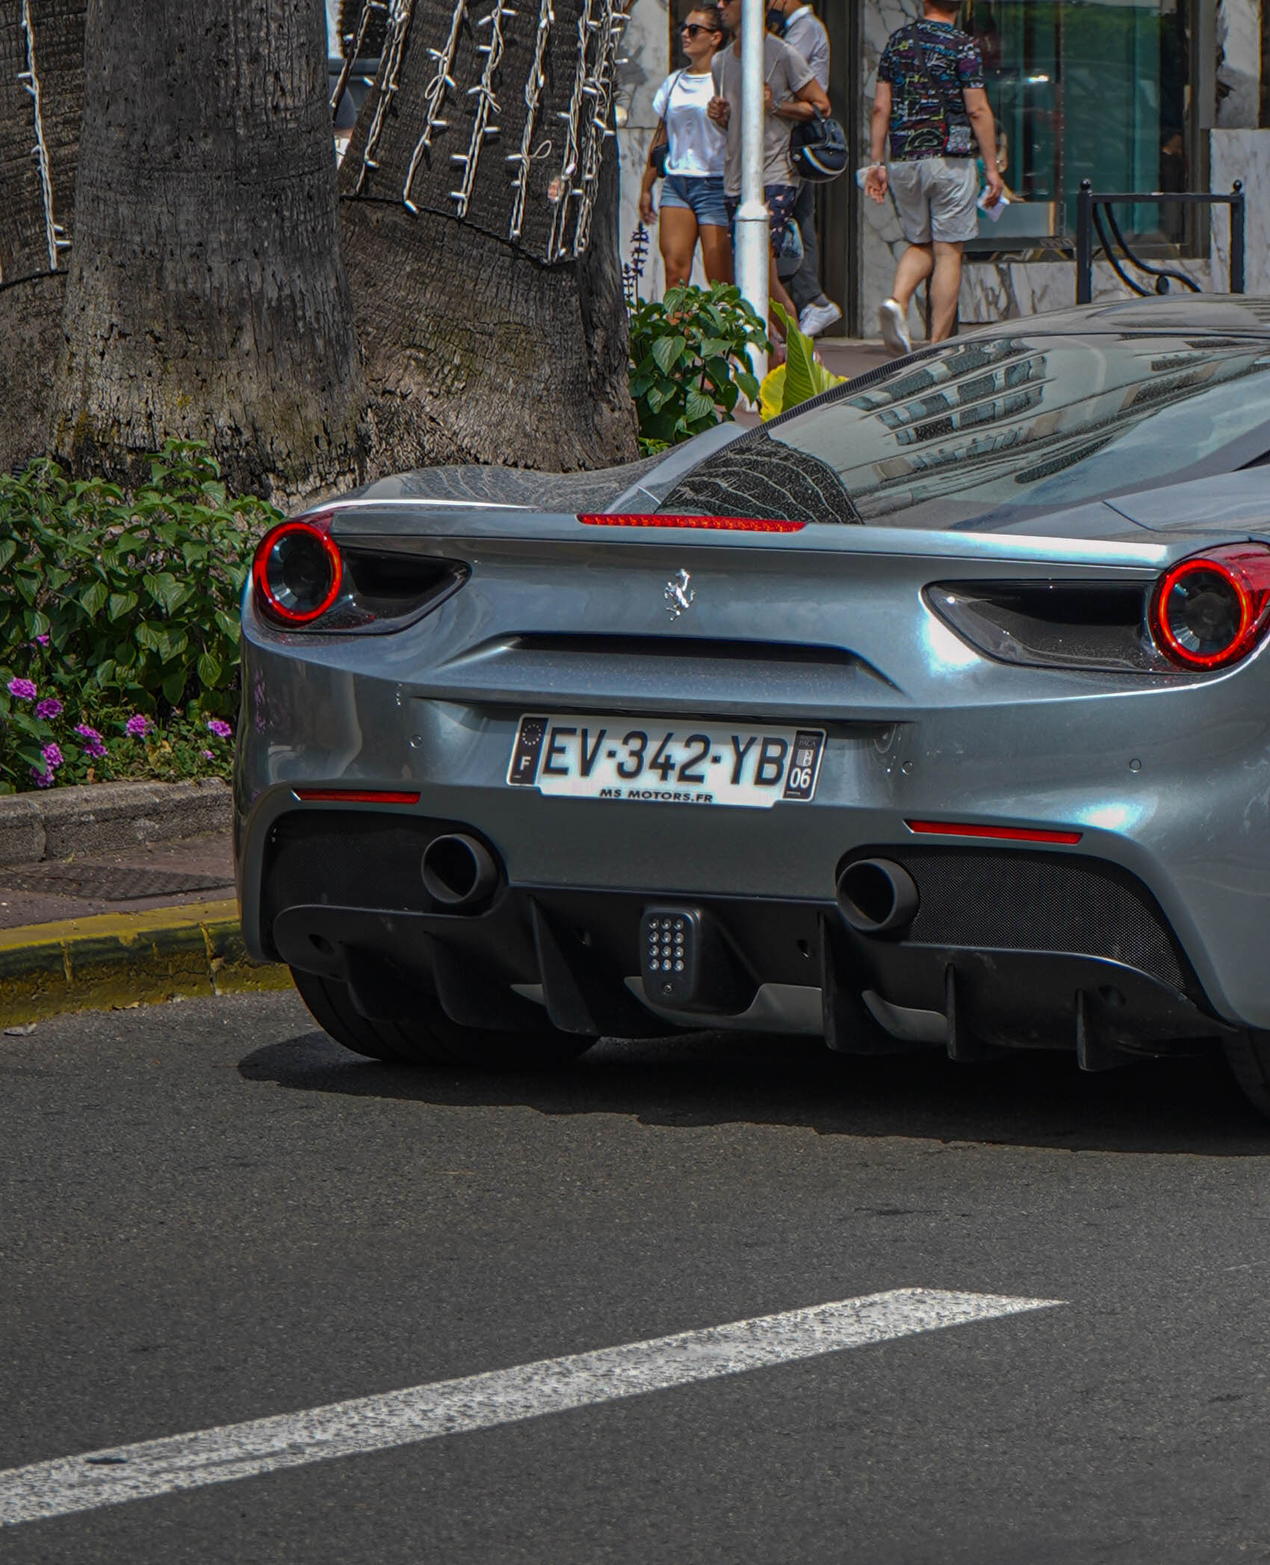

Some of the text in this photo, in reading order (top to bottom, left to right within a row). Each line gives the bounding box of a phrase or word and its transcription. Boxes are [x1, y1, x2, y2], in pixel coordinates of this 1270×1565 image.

[519, 756, 531, 771] F
[542, 726, 788, 786] EV-342-YB
[789, 768, 812, 788] 06
[600, 788, 713, 803] MS MOTORS.FR
